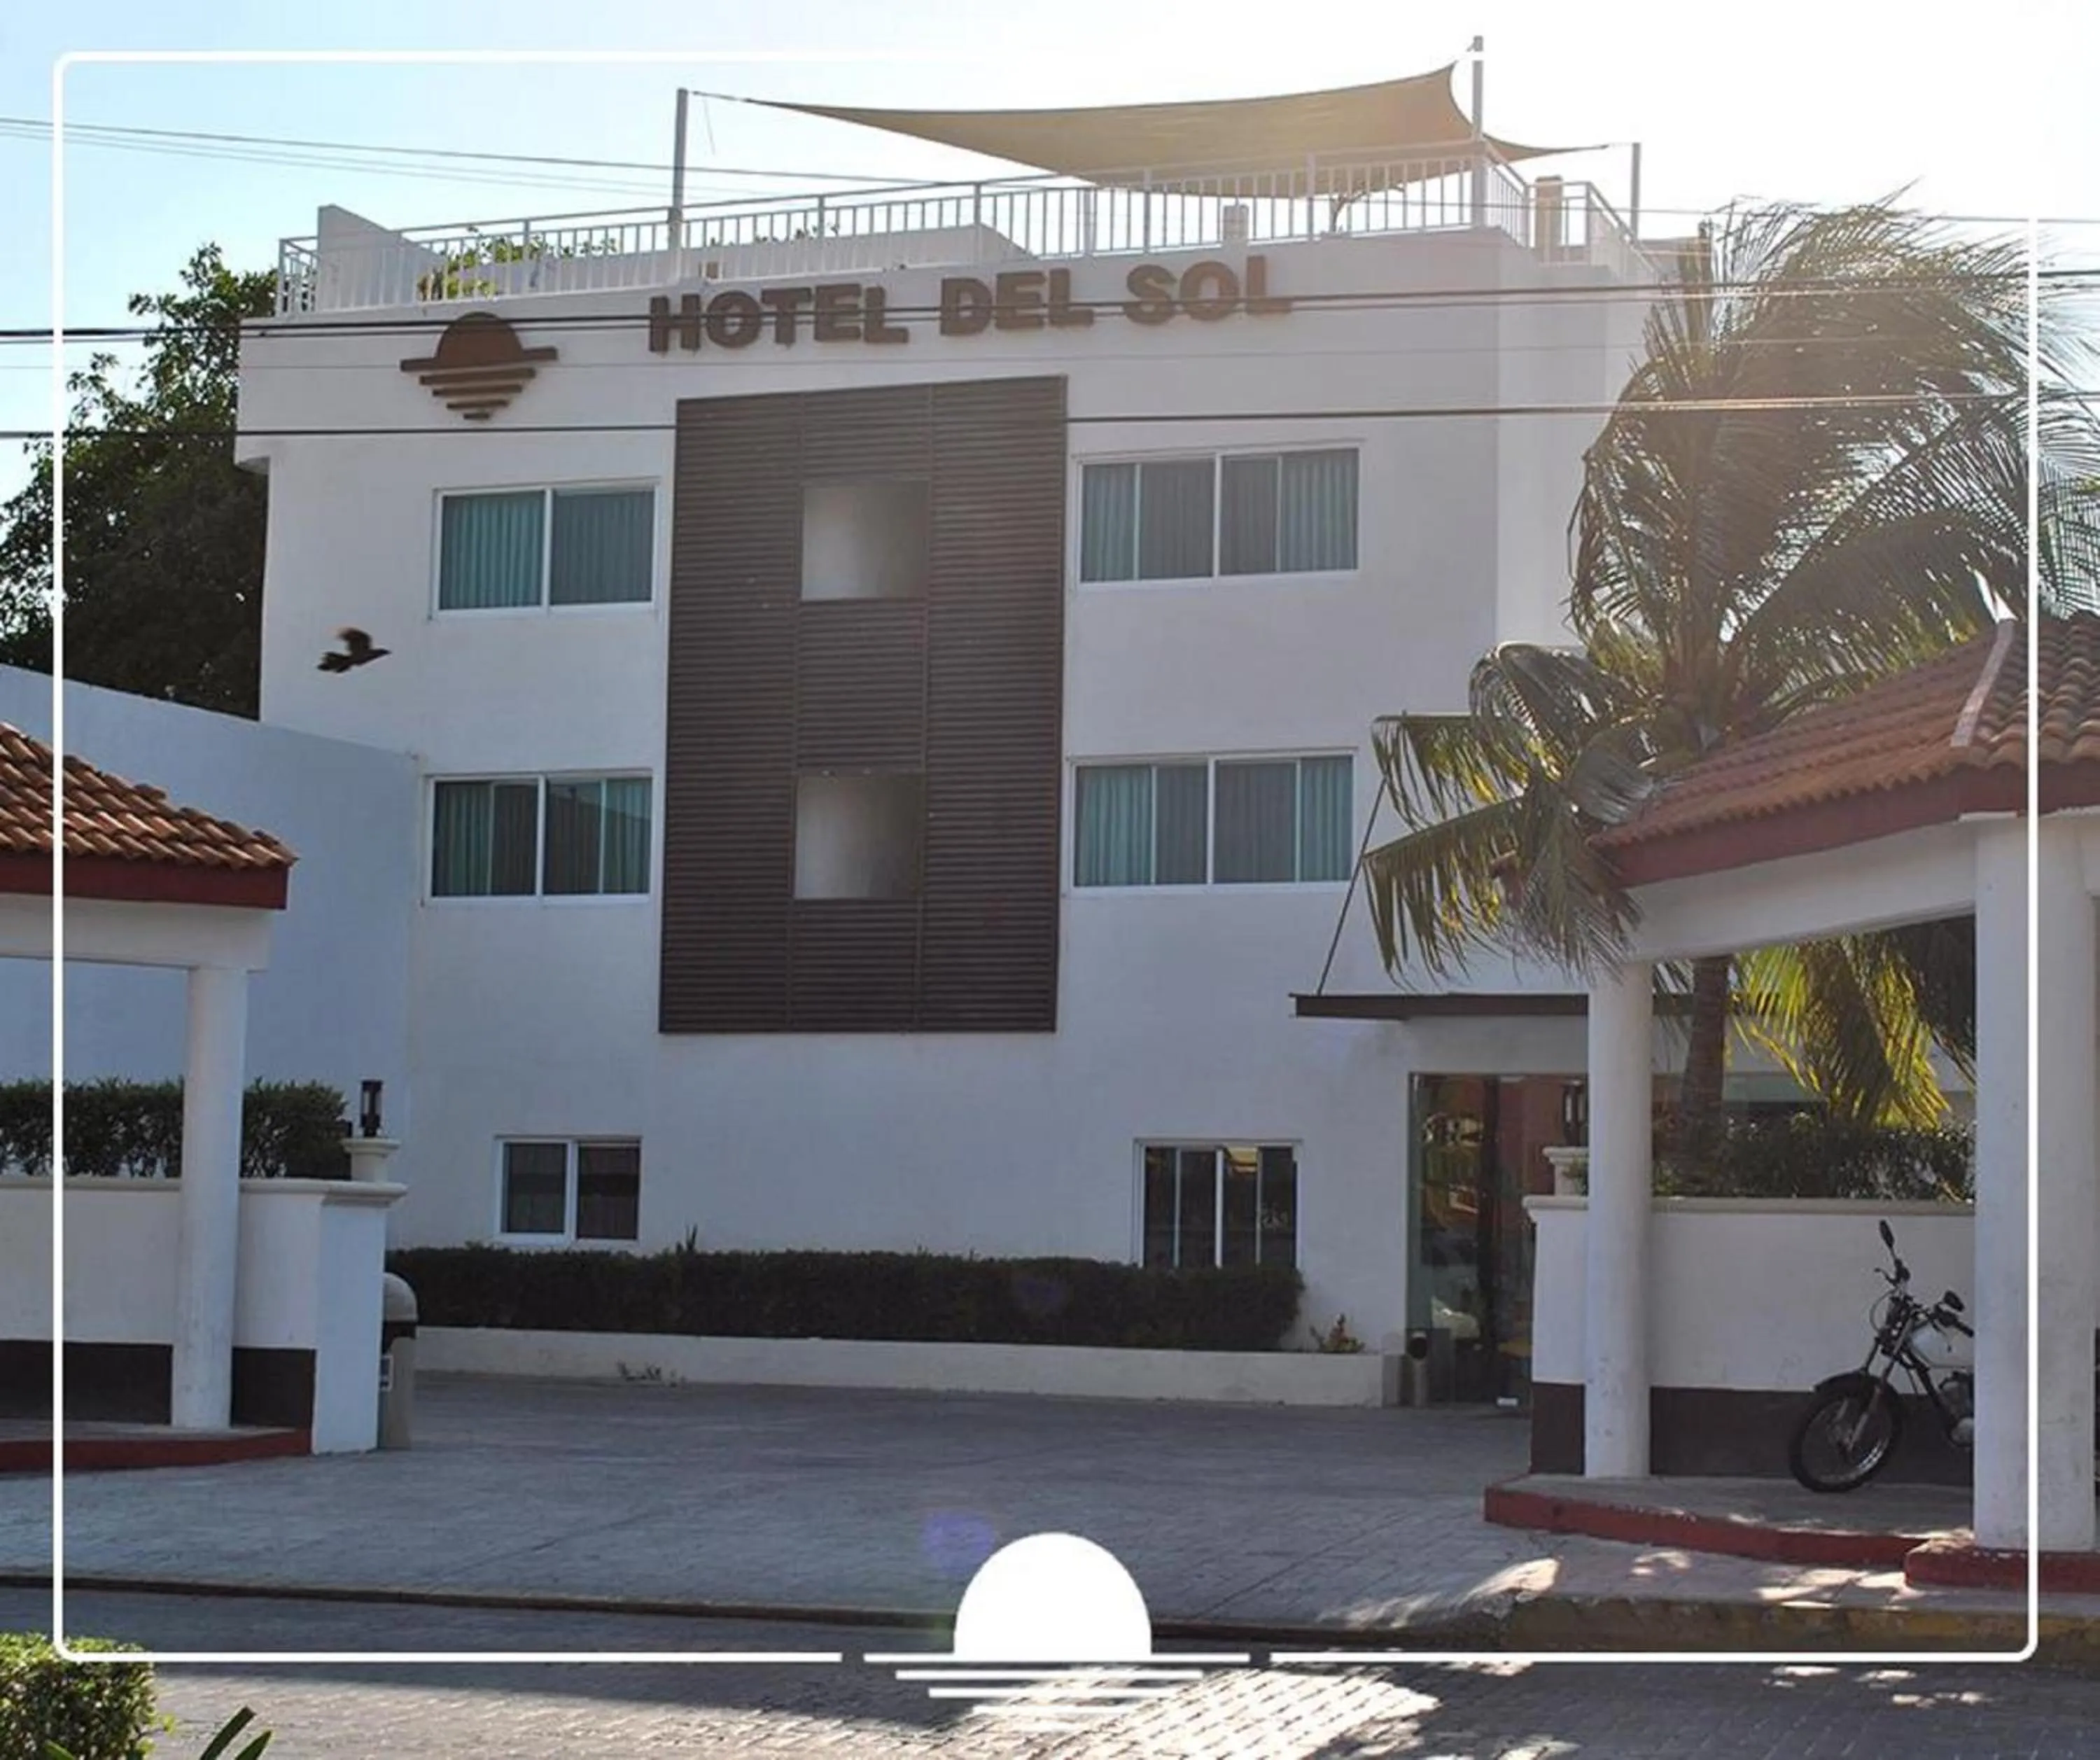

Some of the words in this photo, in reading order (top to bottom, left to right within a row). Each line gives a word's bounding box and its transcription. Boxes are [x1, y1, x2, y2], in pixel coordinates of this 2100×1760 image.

[650, 284, 909, 352] HOTEL
[940, 268, 1095, 336] DEL
[1124, 256, 1293, 324] SOL
